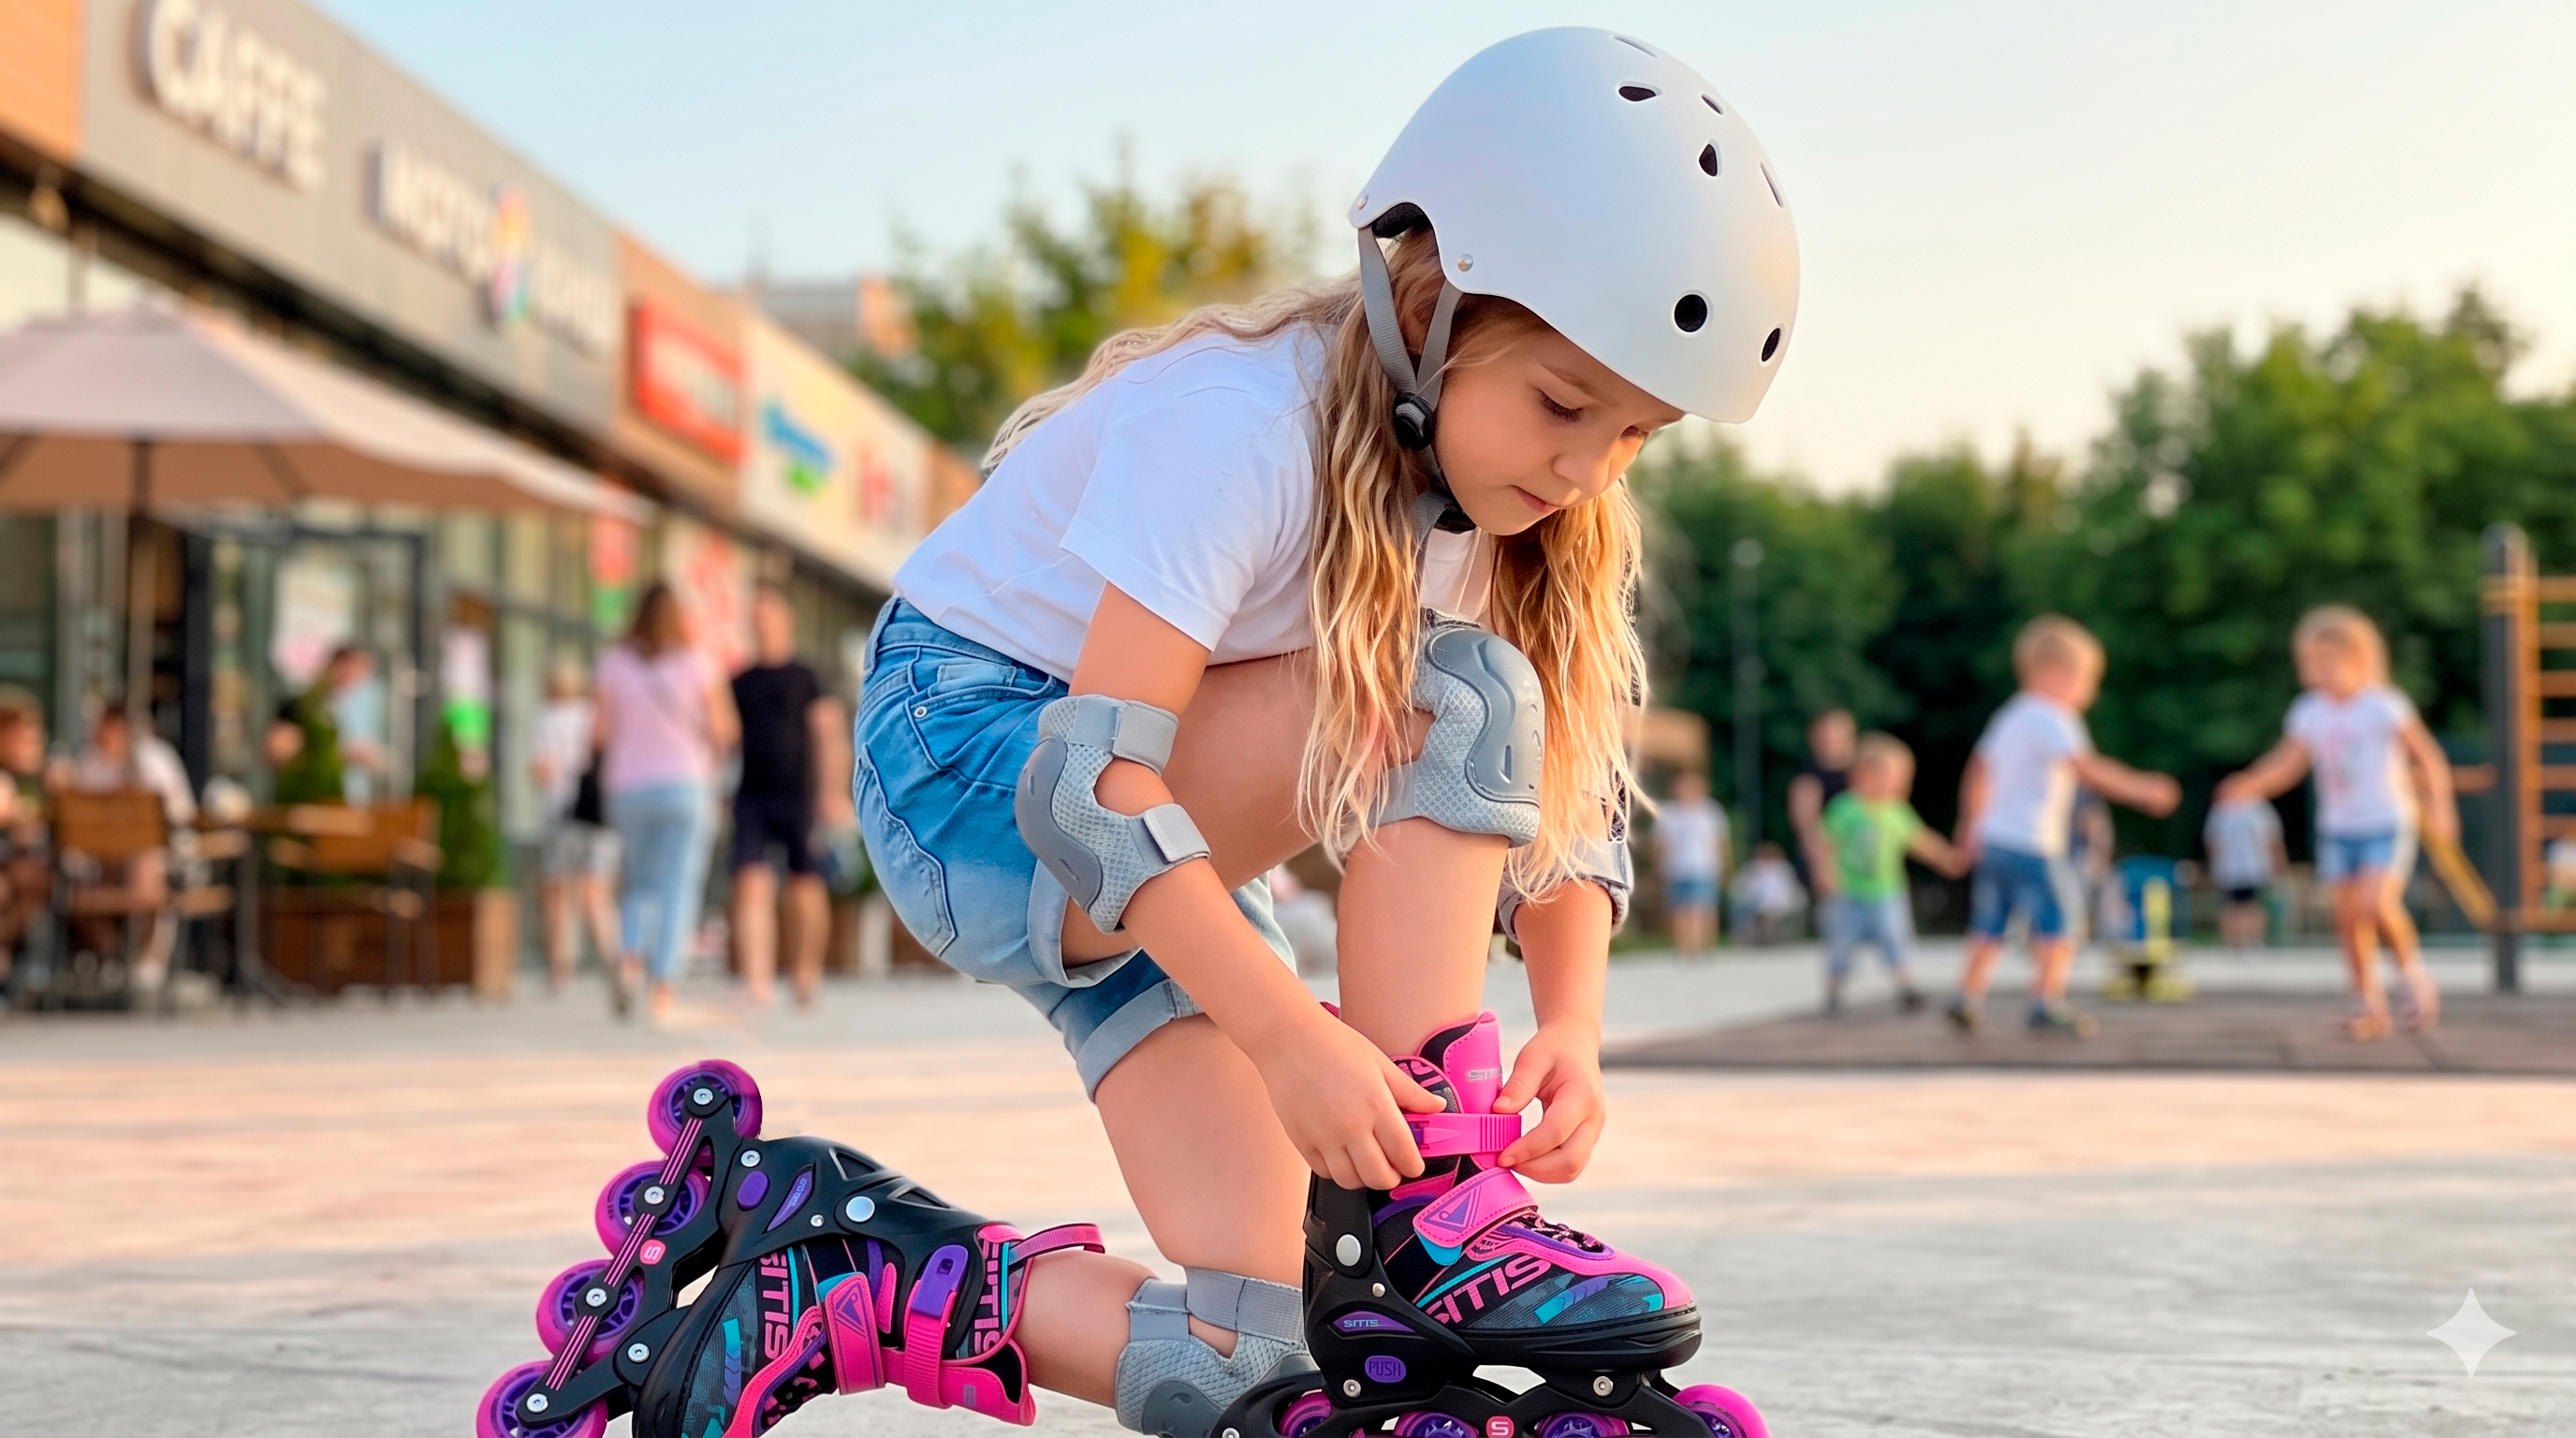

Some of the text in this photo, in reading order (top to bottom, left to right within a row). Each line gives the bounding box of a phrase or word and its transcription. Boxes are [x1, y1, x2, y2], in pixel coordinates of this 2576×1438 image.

[140, 0, 325, 191] CAFFE
[1343, 1319, 1379, 1328] SITIS
[1368, 1360, 1401, 1377] PUSH
[1490, 1421, 1509, 1436] S
